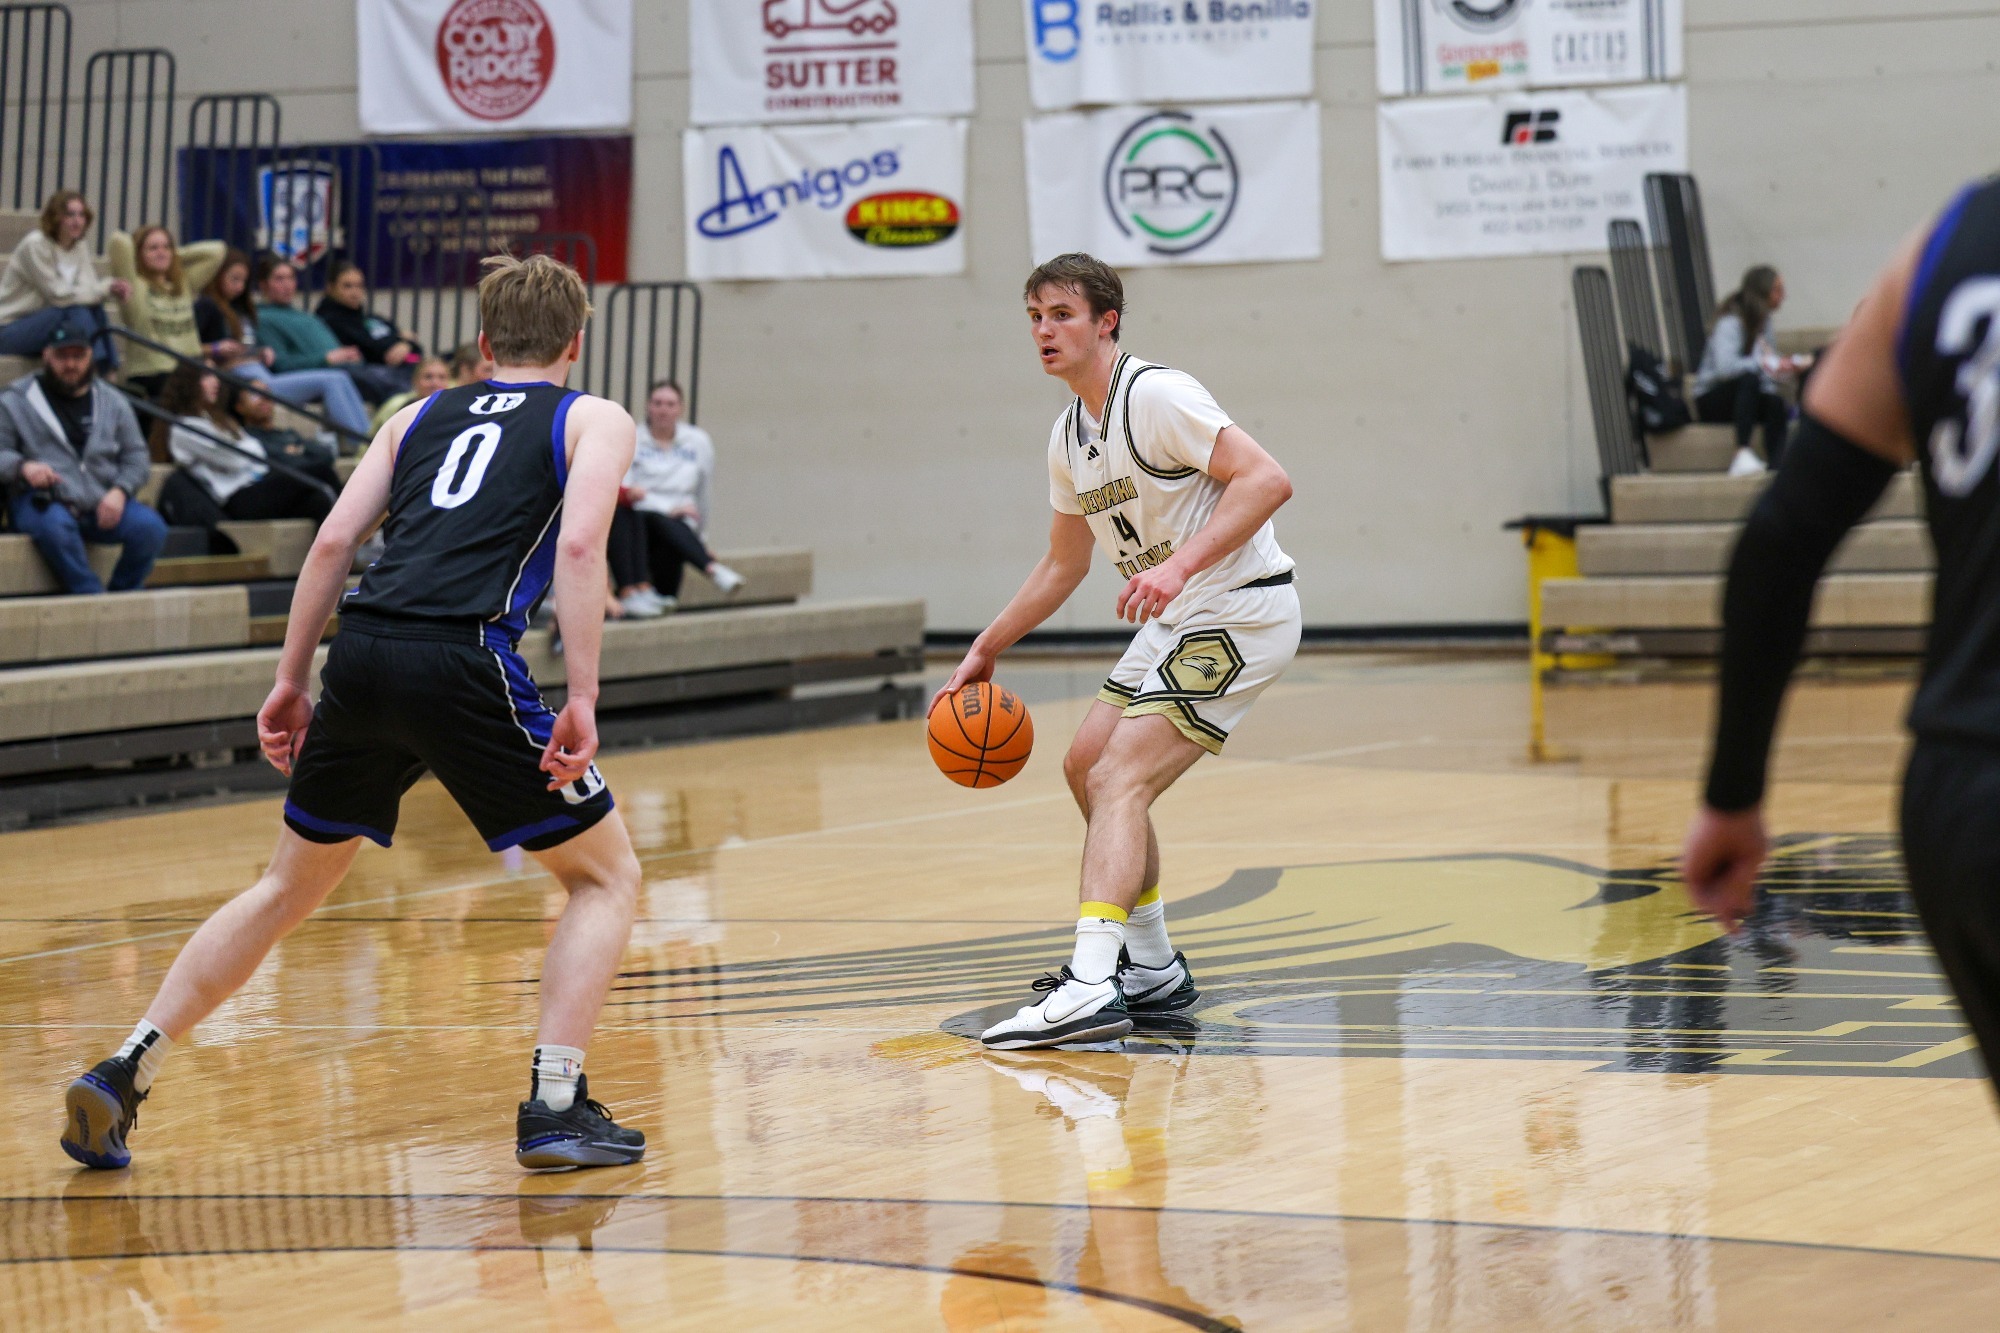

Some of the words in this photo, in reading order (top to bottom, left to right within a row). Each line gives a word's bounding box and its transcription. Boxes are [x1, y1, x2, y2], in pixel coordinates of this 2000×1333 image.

[1182, 0, 1199, 24] &
[450, 53, 542, 86] RIDGE
[766, 57, 898, 89] SUTTER
[696, 145, 900, 239] Amigos
[1119, 163, 1225, 203] PRC
[859, 197, 949, 223] KINGS
[431, 421, 502, 509] 0
